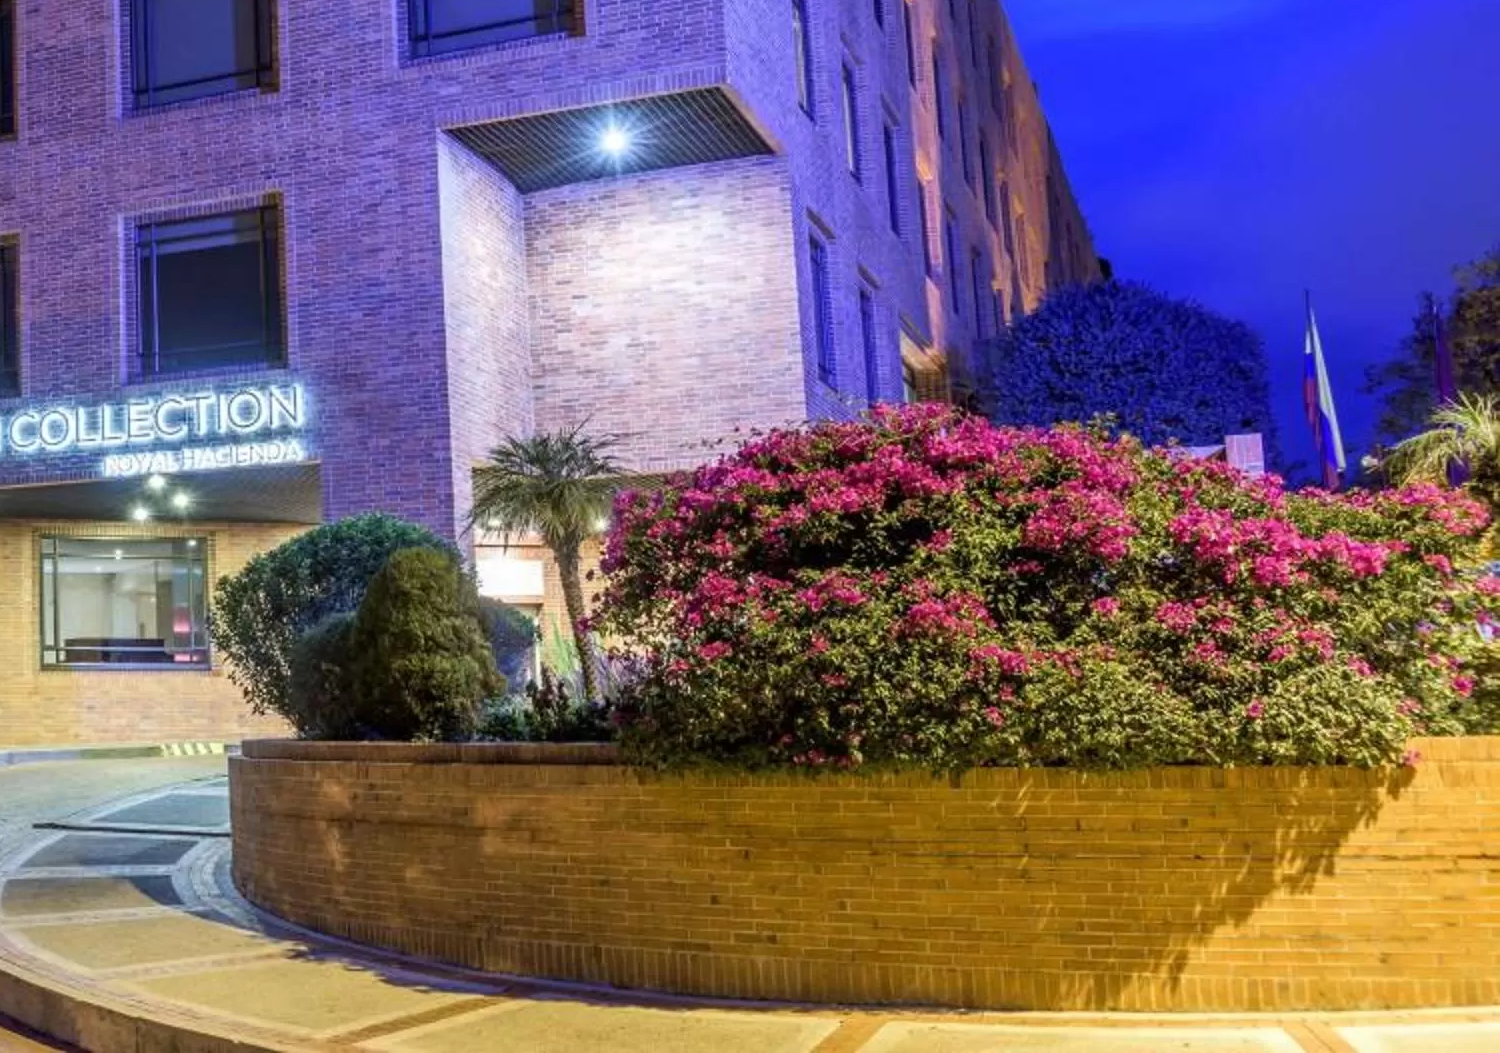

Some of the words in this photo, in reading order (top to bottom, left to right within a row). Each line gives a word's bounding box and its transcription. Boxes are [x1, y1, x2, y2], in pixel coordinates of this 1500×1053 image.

[10, 385, 303, 450] COLLECTION
[103, 450, 181, 477] ROYAL
[182, 440, 303, 471] HACIENDA
